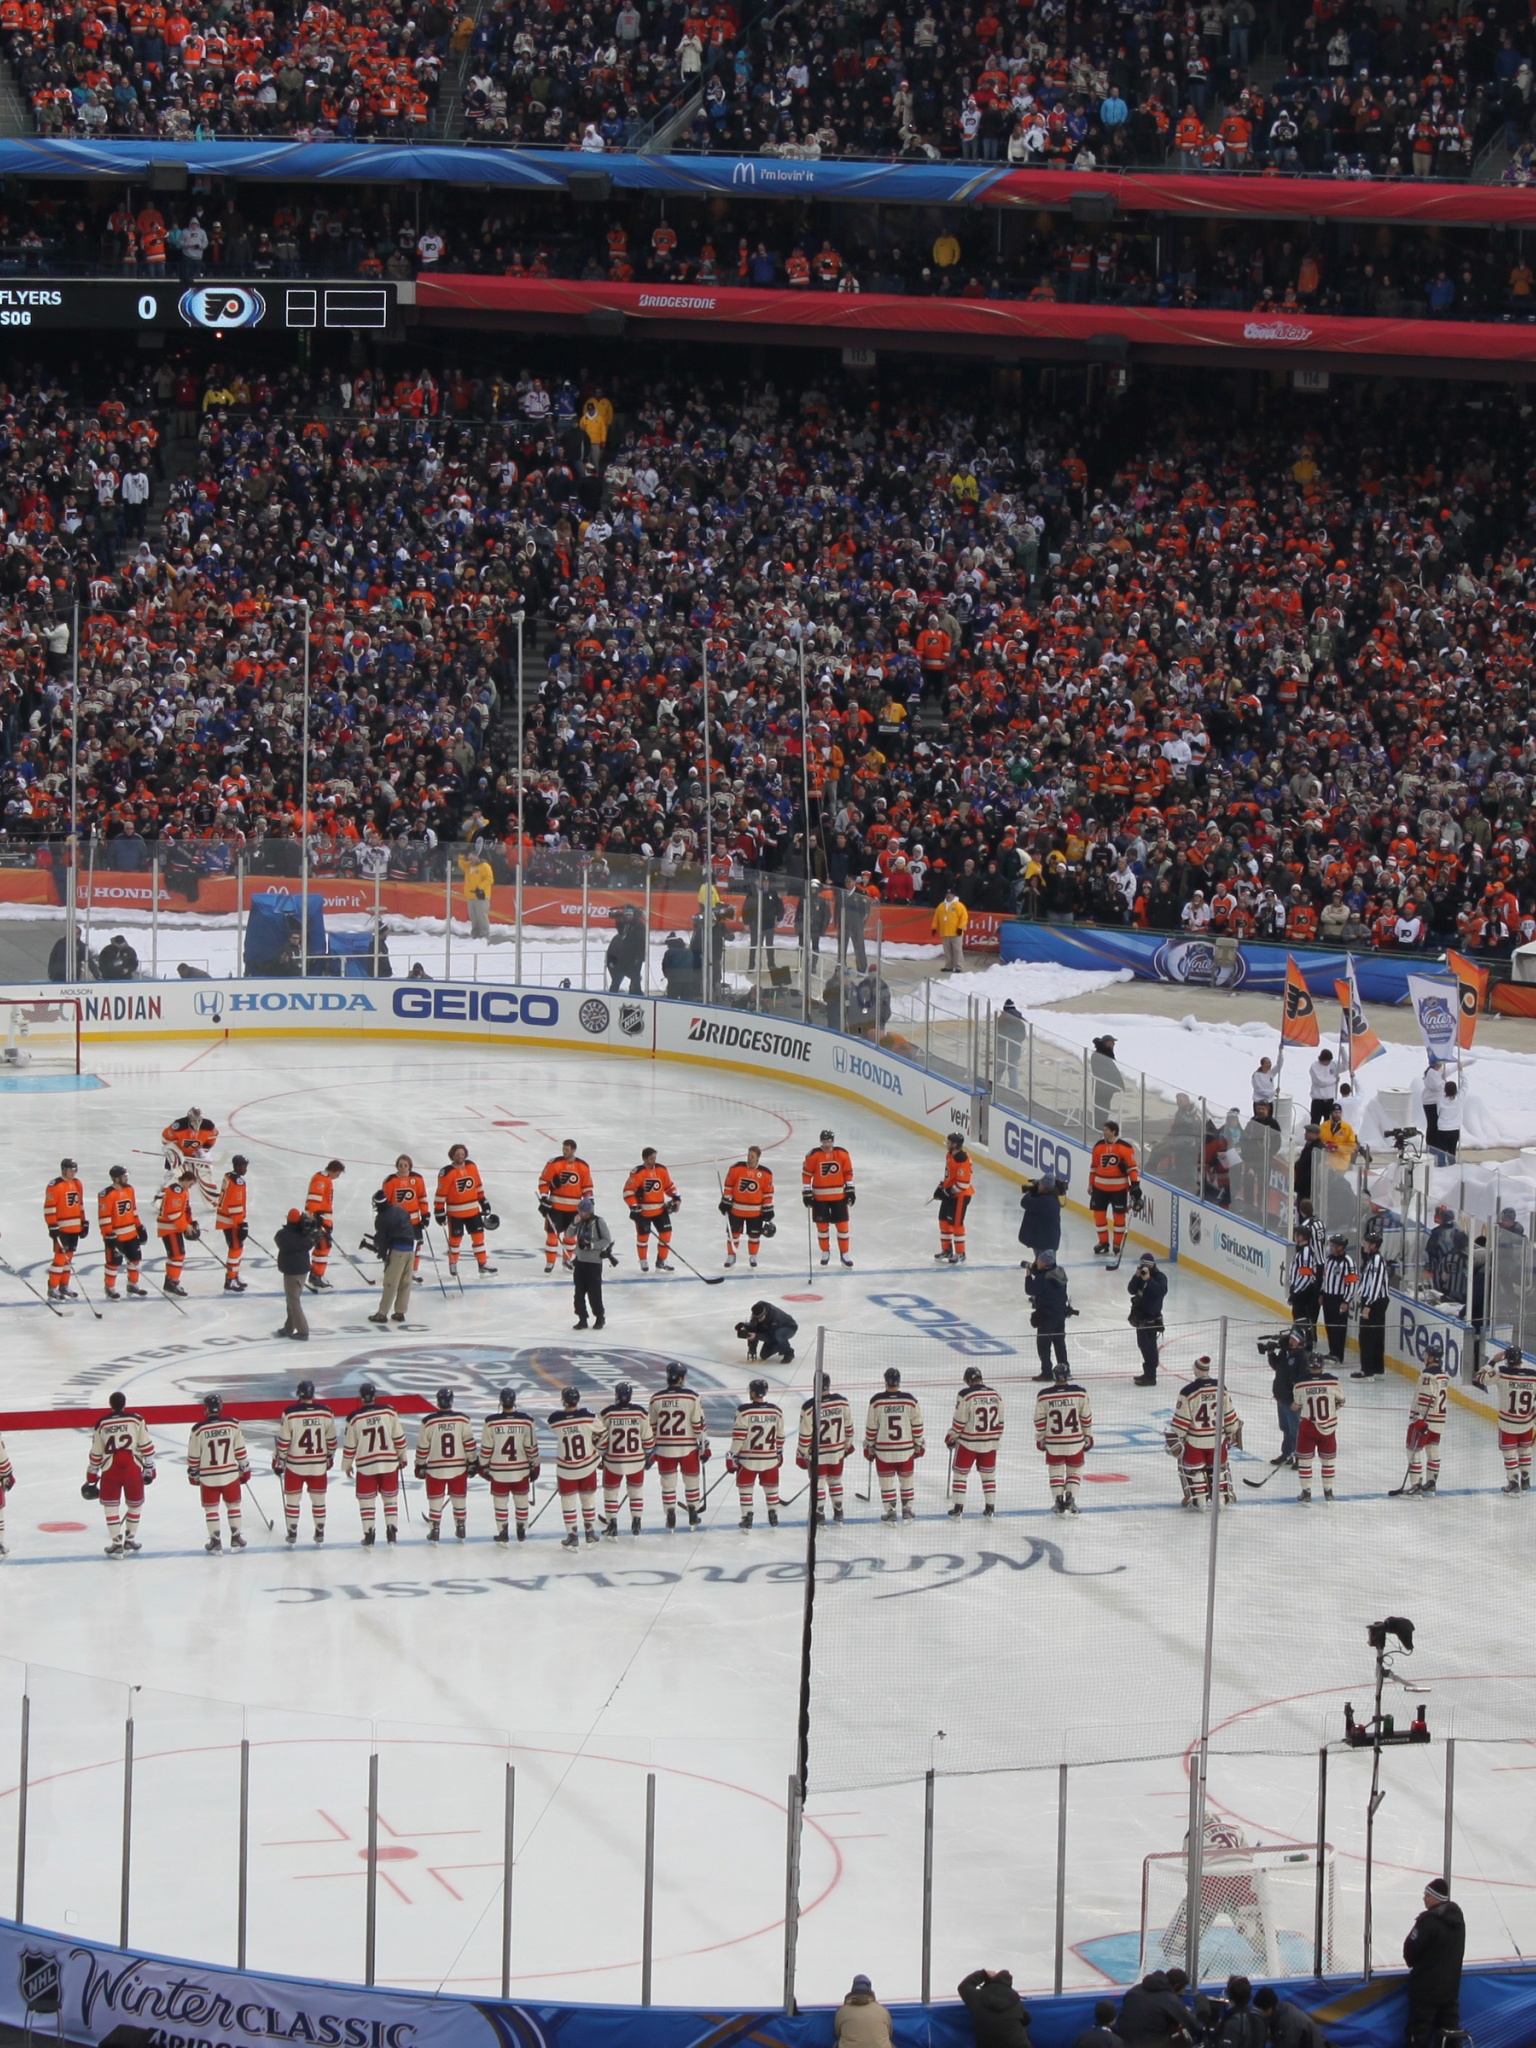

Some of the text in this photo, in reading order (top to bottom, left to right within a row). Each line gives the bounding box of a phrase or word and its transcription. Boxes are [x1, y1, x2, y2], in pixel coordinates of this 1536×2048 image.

[760, 169, 814, 182] i'm lovin' it
[0, 291, 62, 305] FLYERS
[138, 296, 157, 320] 0
[638, 294, 717, 310] BRIDGESTONE
[0, 311, 32, 325] SOG
[1303, 370, 1320, 386] 114
[94, 887, 171, 900] HONDA
[323, 896, 361, 907] ovin' it
[560, 903, 612, 918] verizo
[229, 993, 378, 1011] HONDA
[392, 987, 559, 1026] GEICO
[623, 1013, 640, 1029] NHL
[687, 1017, 813, 1063] BRIDGESTONE
[849, 1054, 903, 1096] HONDA
[1004, 1120, 1072, 1185] GEICO
[866, 1293, 1018, 1356] GEICO
[62, 1343, 200, 1387] WINTER
[201, 1323, 431, 1347] CLSSIC
[1422, 1377, 1431, 1386] 21
[1508, 1381, 1534, 1390] RICHARDS
[661, 1399, 679, 1408] BOYLE
[820, 1408, 843, 1418] DONAGH
[884, 1405, 905, 1414] GIRARDI
[1048, 1399, 1074, 1408] MITCHELL
[1306, 1396, 1330, 1421] 10
[1438, 1389, 1447, 1414] 2
[1508, 1390, 1533, 1415] 19
[302, 1418, 321, 1427] BICKEL
[366, 1416, 381, 1426] RUPP
[437, 1423, 456, 1431] PRUST
[658, 1410, 686, 1436] 22
[750, 1415, 778, 1424] CALLAHAN
[819, 1417, 843, 1444] 27
[887, 1415, 902, 1441] 5
[975, 1406, 999, 1432] 32
[1048, 1408, 1079, 1434] 34
[104, 1433, 133, 1455] 42
[204, 1428, 231, 1439] DUBINSKY
[298, 1428, 323, 1454] 41
[362, 1426, 388, 1453] 71
[441, 1433, 455, 1458] 8
[611, 1428, 639, 1453] 26
[750, 1425, 776, 1450] 24
[207, 1438, 231, 1466] 17
[501, 1436, 517, 1461] 4
[562, 1434, 585, 1461] 18
[28, 1966, 57, 1997] NHL
[70, 1947, 419, 2048] Winter CLASSIC
